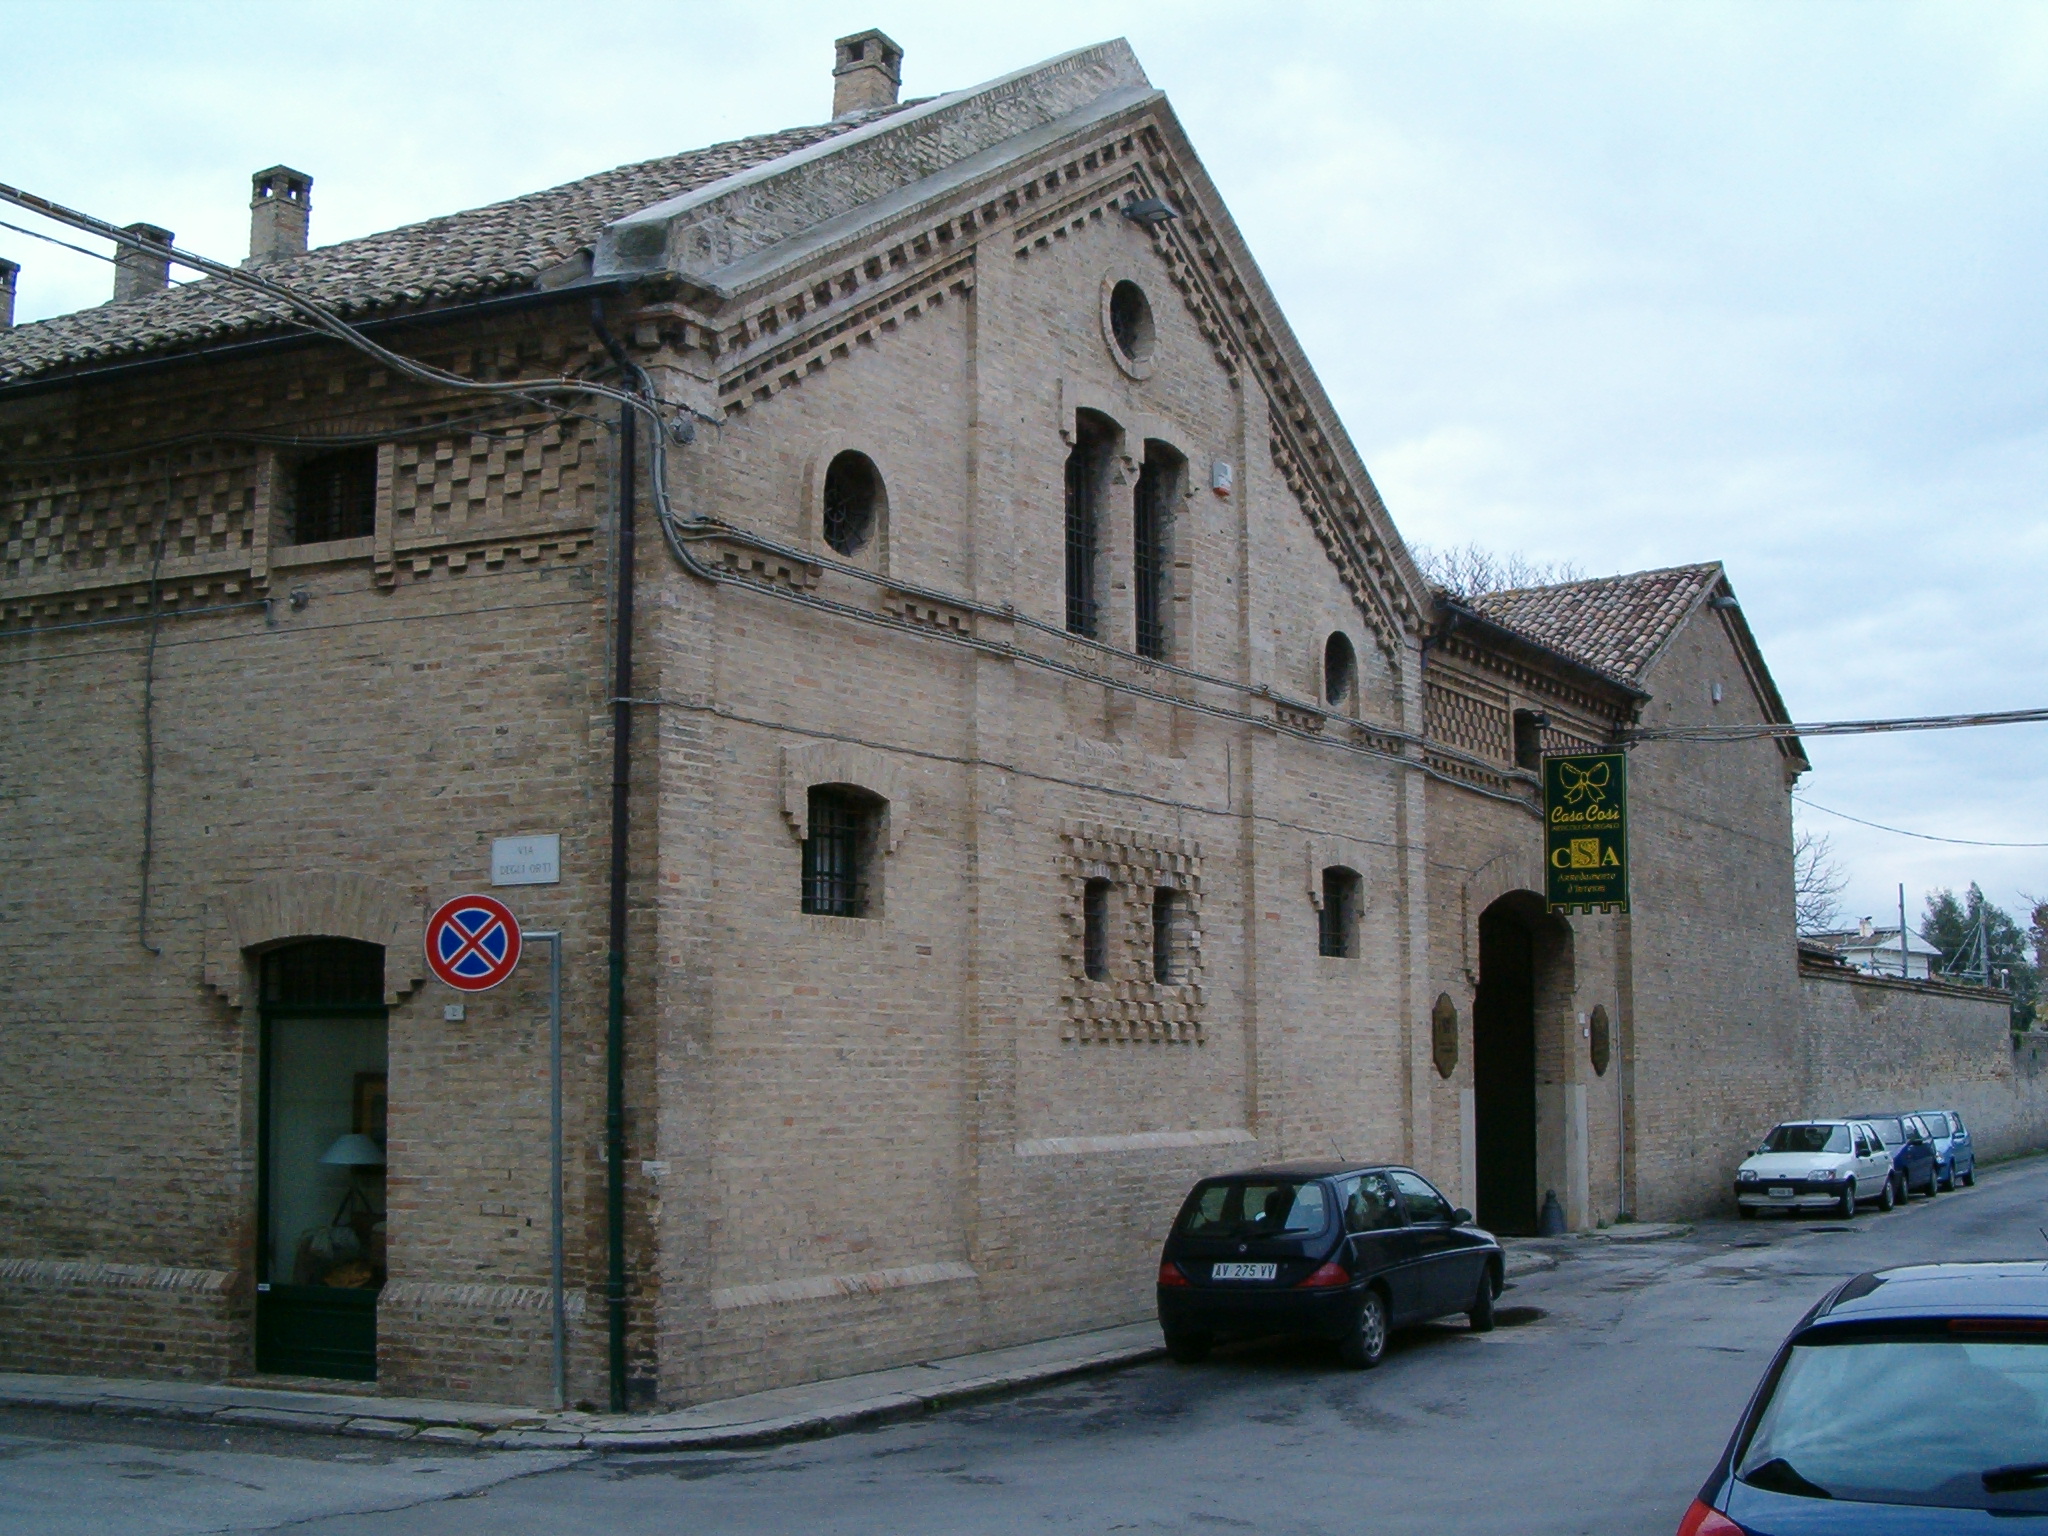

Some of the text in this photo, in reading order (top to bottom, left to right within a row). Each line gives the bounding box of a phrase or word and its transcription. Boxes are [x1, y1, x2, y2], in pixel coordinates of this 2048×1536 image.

[1551, 804, 1620, 823] Casa Così
[518, 846, 533, 855] VIA
[500, 862, 551, 875] DEGLI ORTI
[1216, 1265, 1229, 1276] AV
[1234, 1265, 1256, 1276] 275
